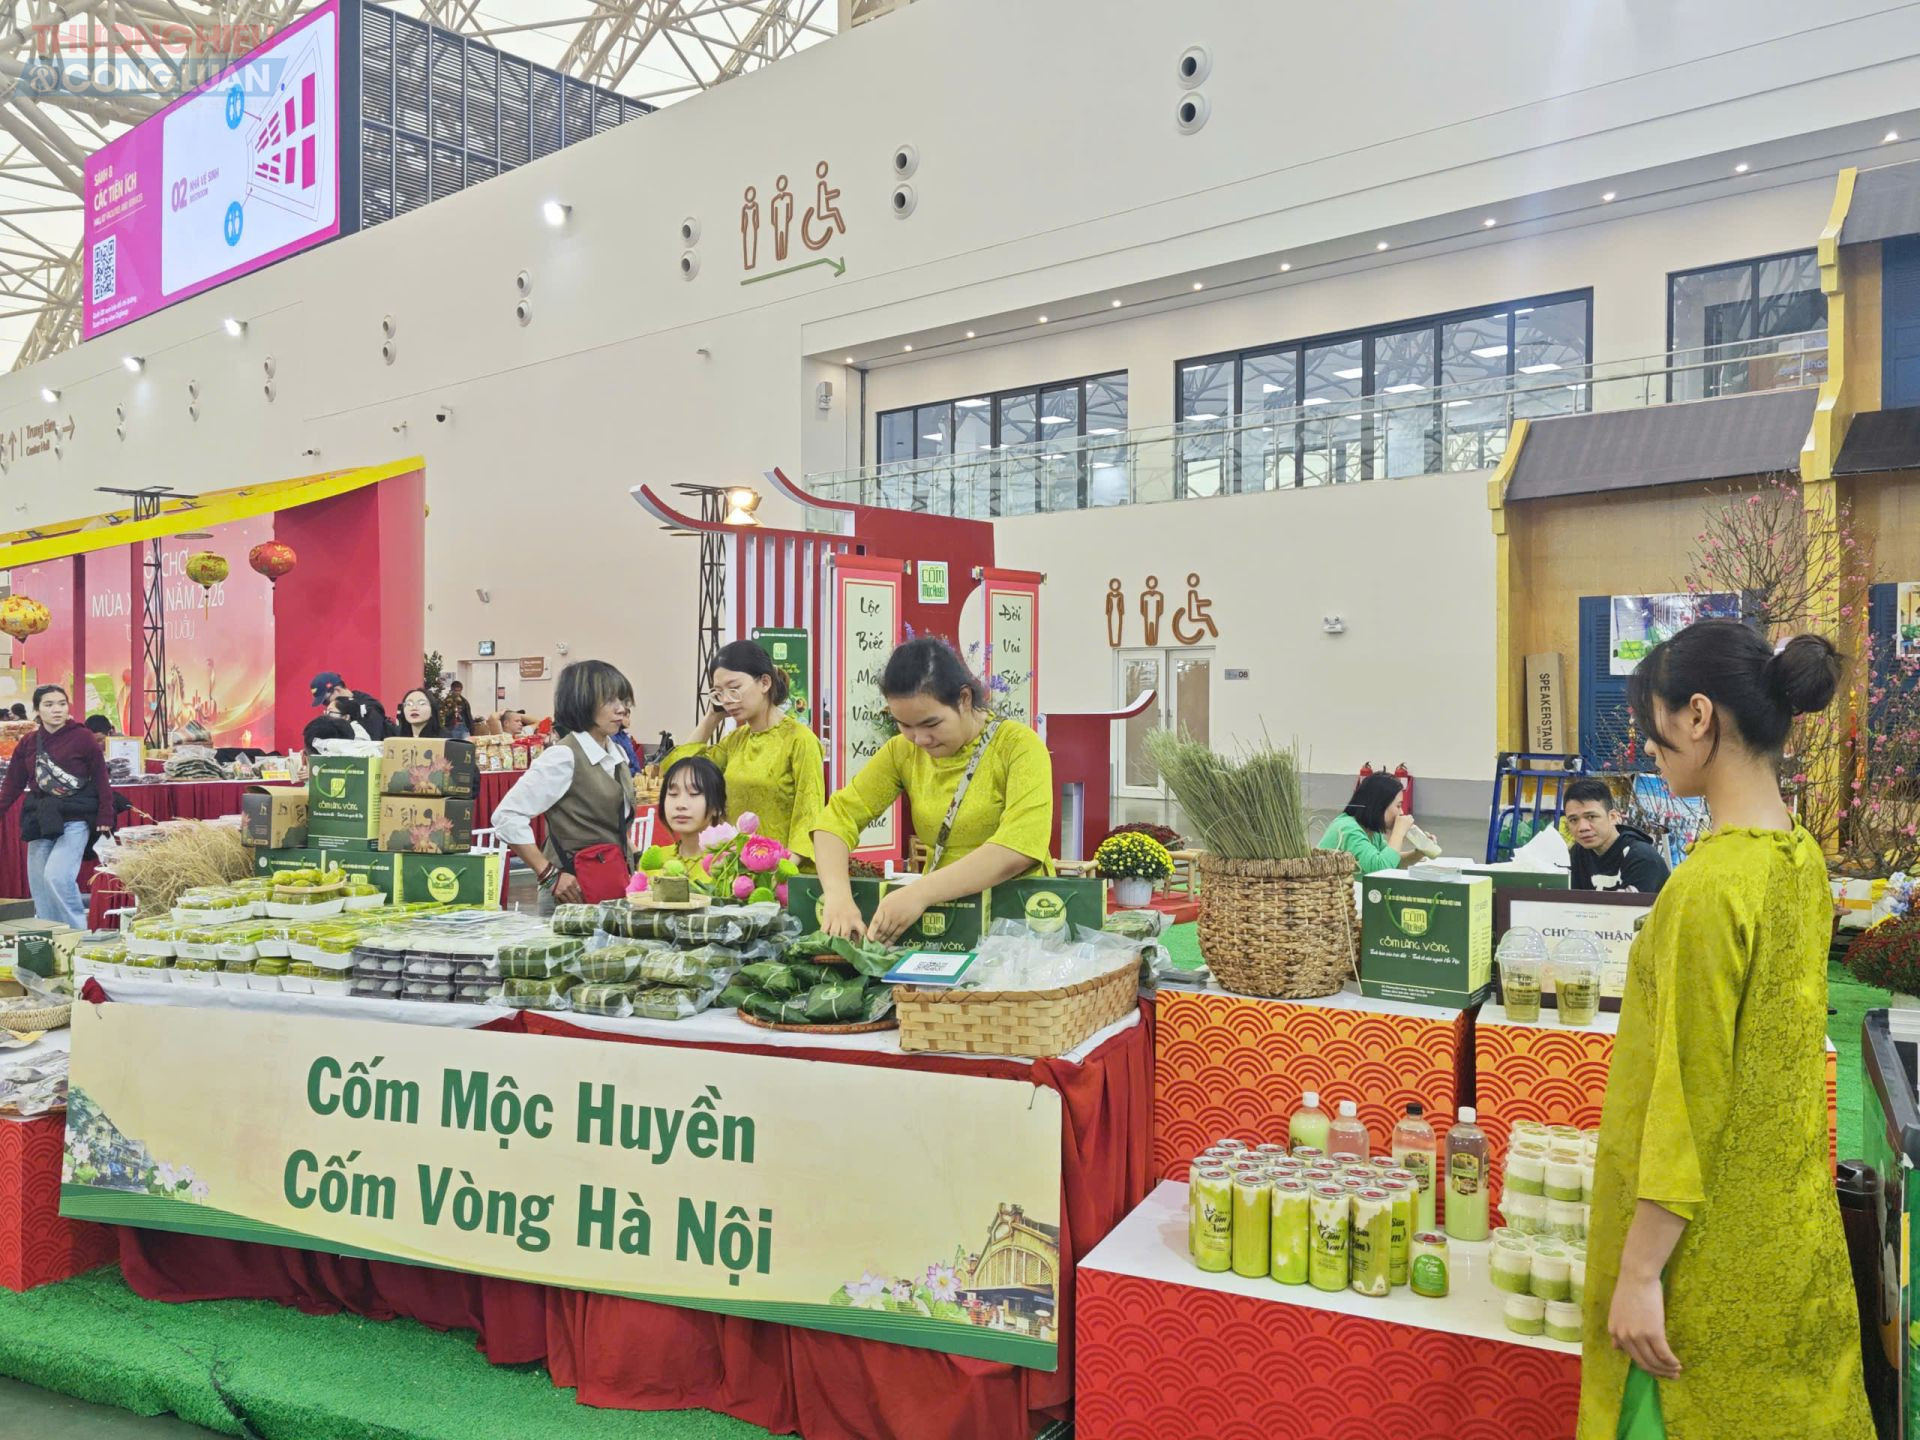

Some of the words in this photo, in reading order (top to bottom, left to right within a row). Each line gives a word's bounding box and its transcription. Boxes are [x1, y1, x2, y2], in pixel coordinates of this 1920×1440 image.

[94, 187, 108, 212] CÁC
[109, 179, 123, 204] TIỆN
[124, 170, 137, 195] ÍCH
[171, 177, 188, 213] 02
[92, 589, 124, 618] MÙA
[166, 582, 195, 612] NĂM
[860, 596, 880, 617] Lộc
[998, 603, 1022, 622] Đời
[1003, 637, 1021, 654] Vui
[1539, 672, 1553, 752] SPEAKERSTAND
[852, 740, 881, 759] Xuâ
[1595, 930, 1633, 943] NHẬN
[306, 1055, 420, 1125] Cốm
[440, 1067, 555, 1150] Mộc
[576, 1080, 756, 1164] Huyền
[283, 1148, 397, 1220] Cốm
[417, 1162, 555, 1253] Vòng
[576, 1183, 652, 1257] Hà
[674, 1196, 774, 1288] Nội
